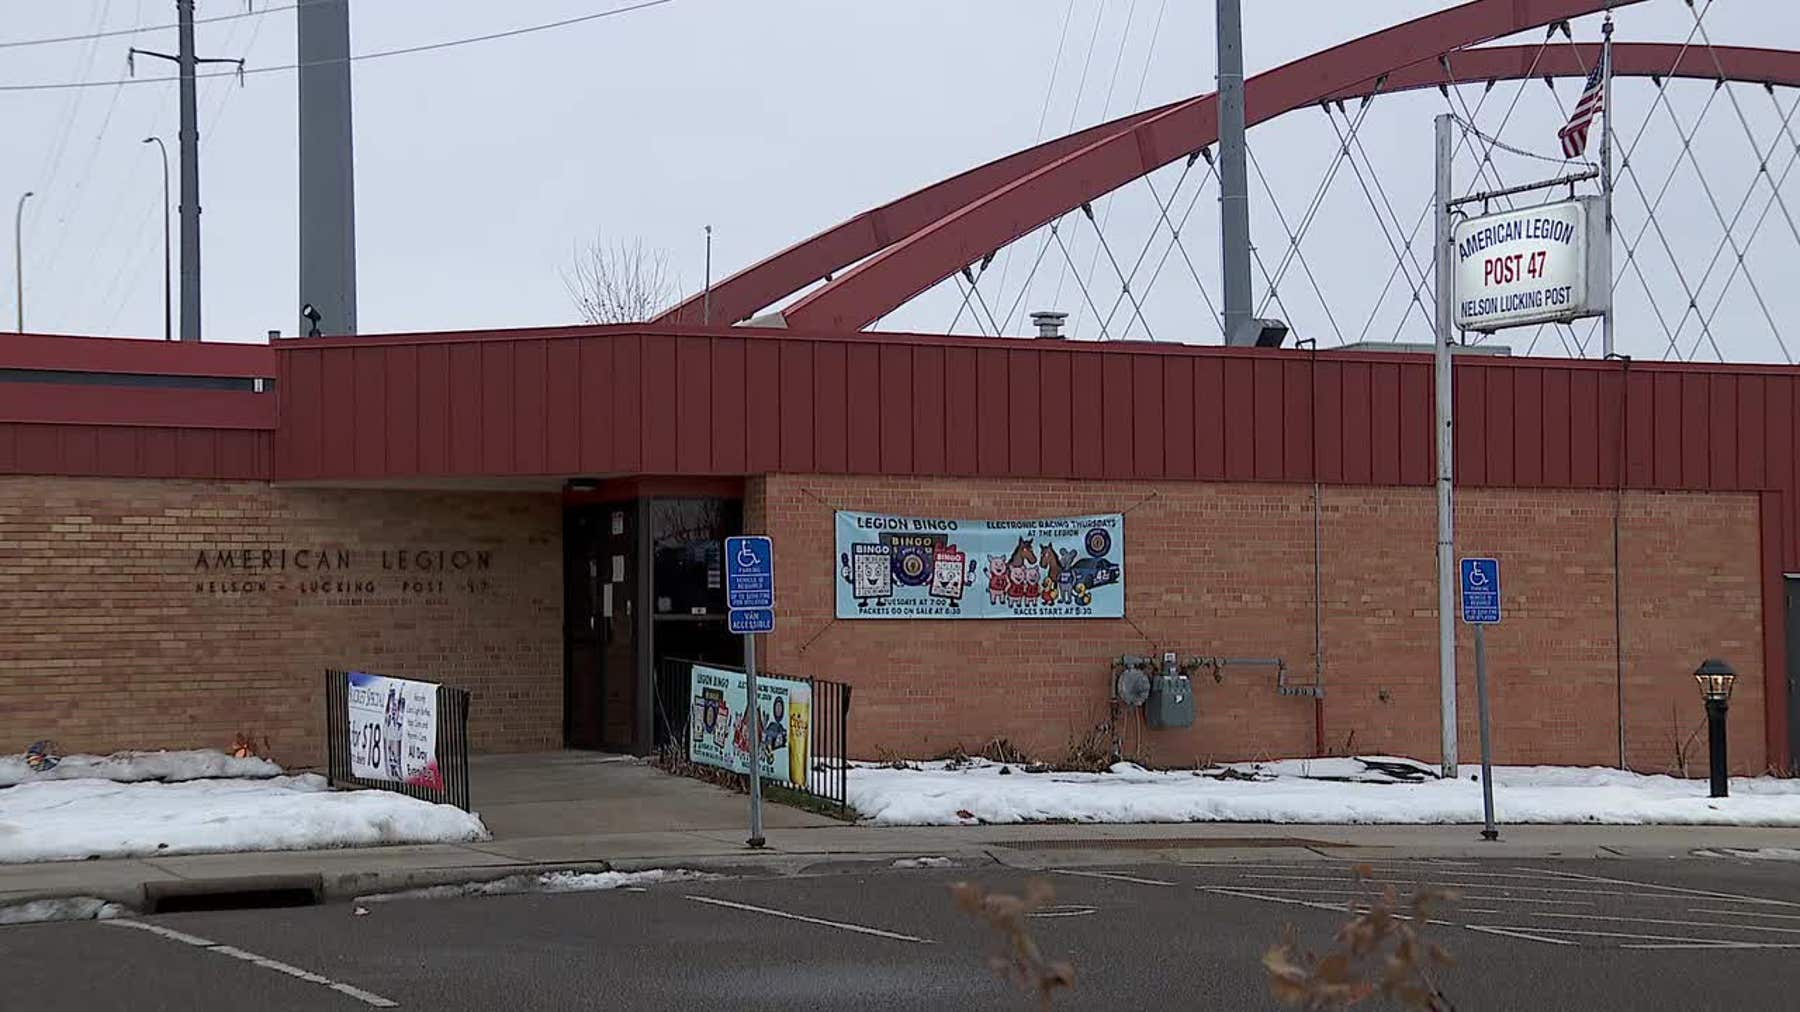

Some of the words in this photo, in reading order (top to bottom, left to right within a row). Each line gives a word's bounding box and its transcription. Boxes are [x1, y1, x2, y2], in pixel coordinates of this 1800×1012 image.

[1459, 219, 1522, 262] AMERICAN
[1526, 218, 1575, 245] LEGION
[1484, 253, 1523, 287] POST
[1527, 250, 1546, 279] 47
[1461, 297, 1498, 318] NELSON
[1500, 290, 1542, 313] LUCKING
[1545, 286, 1571, 305] POST
[857, 517, 908, 530] LEGION
[913, 519, 958, 531] BINGO
[986, 520, 1037, 530] ELECTRONIC
[1039, 520, 1069, 529] RACING
[1071, 519, 1116, 529] THURSDAYS
[1054, 529, 1079, 537] LEGION
[892, 537, 932, 546] BINGO
[855, 544, 890, 554] BINGO
[194, 549, 350, 571] AMERICAN
[382, 549, 491, 571] LEGION
[936, 553, 962, 561] BINGO
[195, 581, 267, 593] NELSON
[301, 581, 375, 593] LUCKING
[402, 581, 444, 593] POST
[884, 598, 917, 606] TUESDAYS
[919, 598, 928, 606] AT
[744, 611, 759, 620] VAN
[858, 607, 889, 615] PACKETS
[890, 607, 902, 615] GO
[903, 607, 914, 615] ON
[915, 607, 934, 615] SALE
[934, 607, 944, 615] AT
[732, 620, 771, 629] ACCESSIBLE
[361, 722, 381, 770] $18
[416, 746, 428, 763] Day
